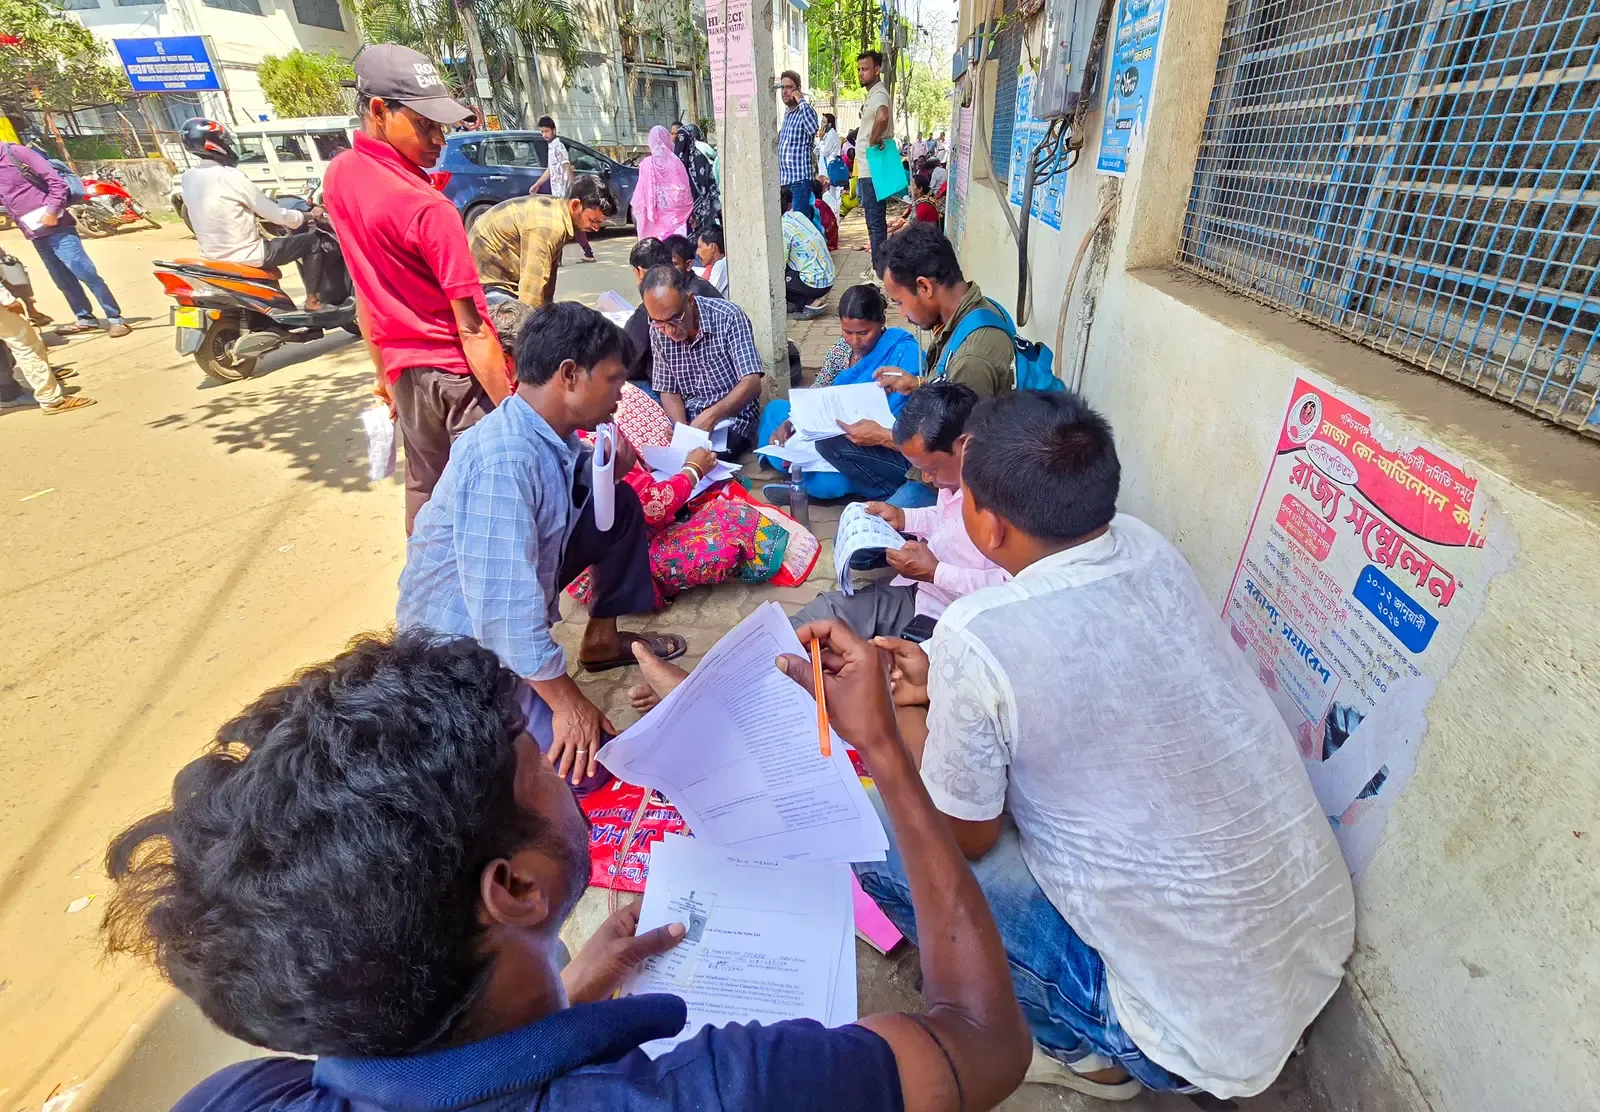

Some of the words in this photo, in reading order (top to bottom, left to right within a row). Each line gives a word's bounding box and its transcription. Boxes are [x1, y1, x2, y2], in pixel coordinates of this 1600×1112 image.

[1308, 439, 1355, 479] একবিংশতিতম
[1319, 419, 1350, 448] রাজ্য
[1351, 440, 1448, 511] কো-অর্ডিনেশন
[1424, 462, 1453, 487] সমিতি
[1287, 454, 1345, 524] রাজ্য
[1344, 497, 1461, 607] সম্মেলন
[1366, 573, 1393, 602] ১০-১২
[1393, 595, 1426, 632] জানুয়ারী
[1376, 601, 1400, 628] ২০২৬
[1243, 578, 1280, 626] প্রকাশ্য
[1280, 621, 1331, 684] সমাবেশ
[1366, 670, 1387, 693] AISG
